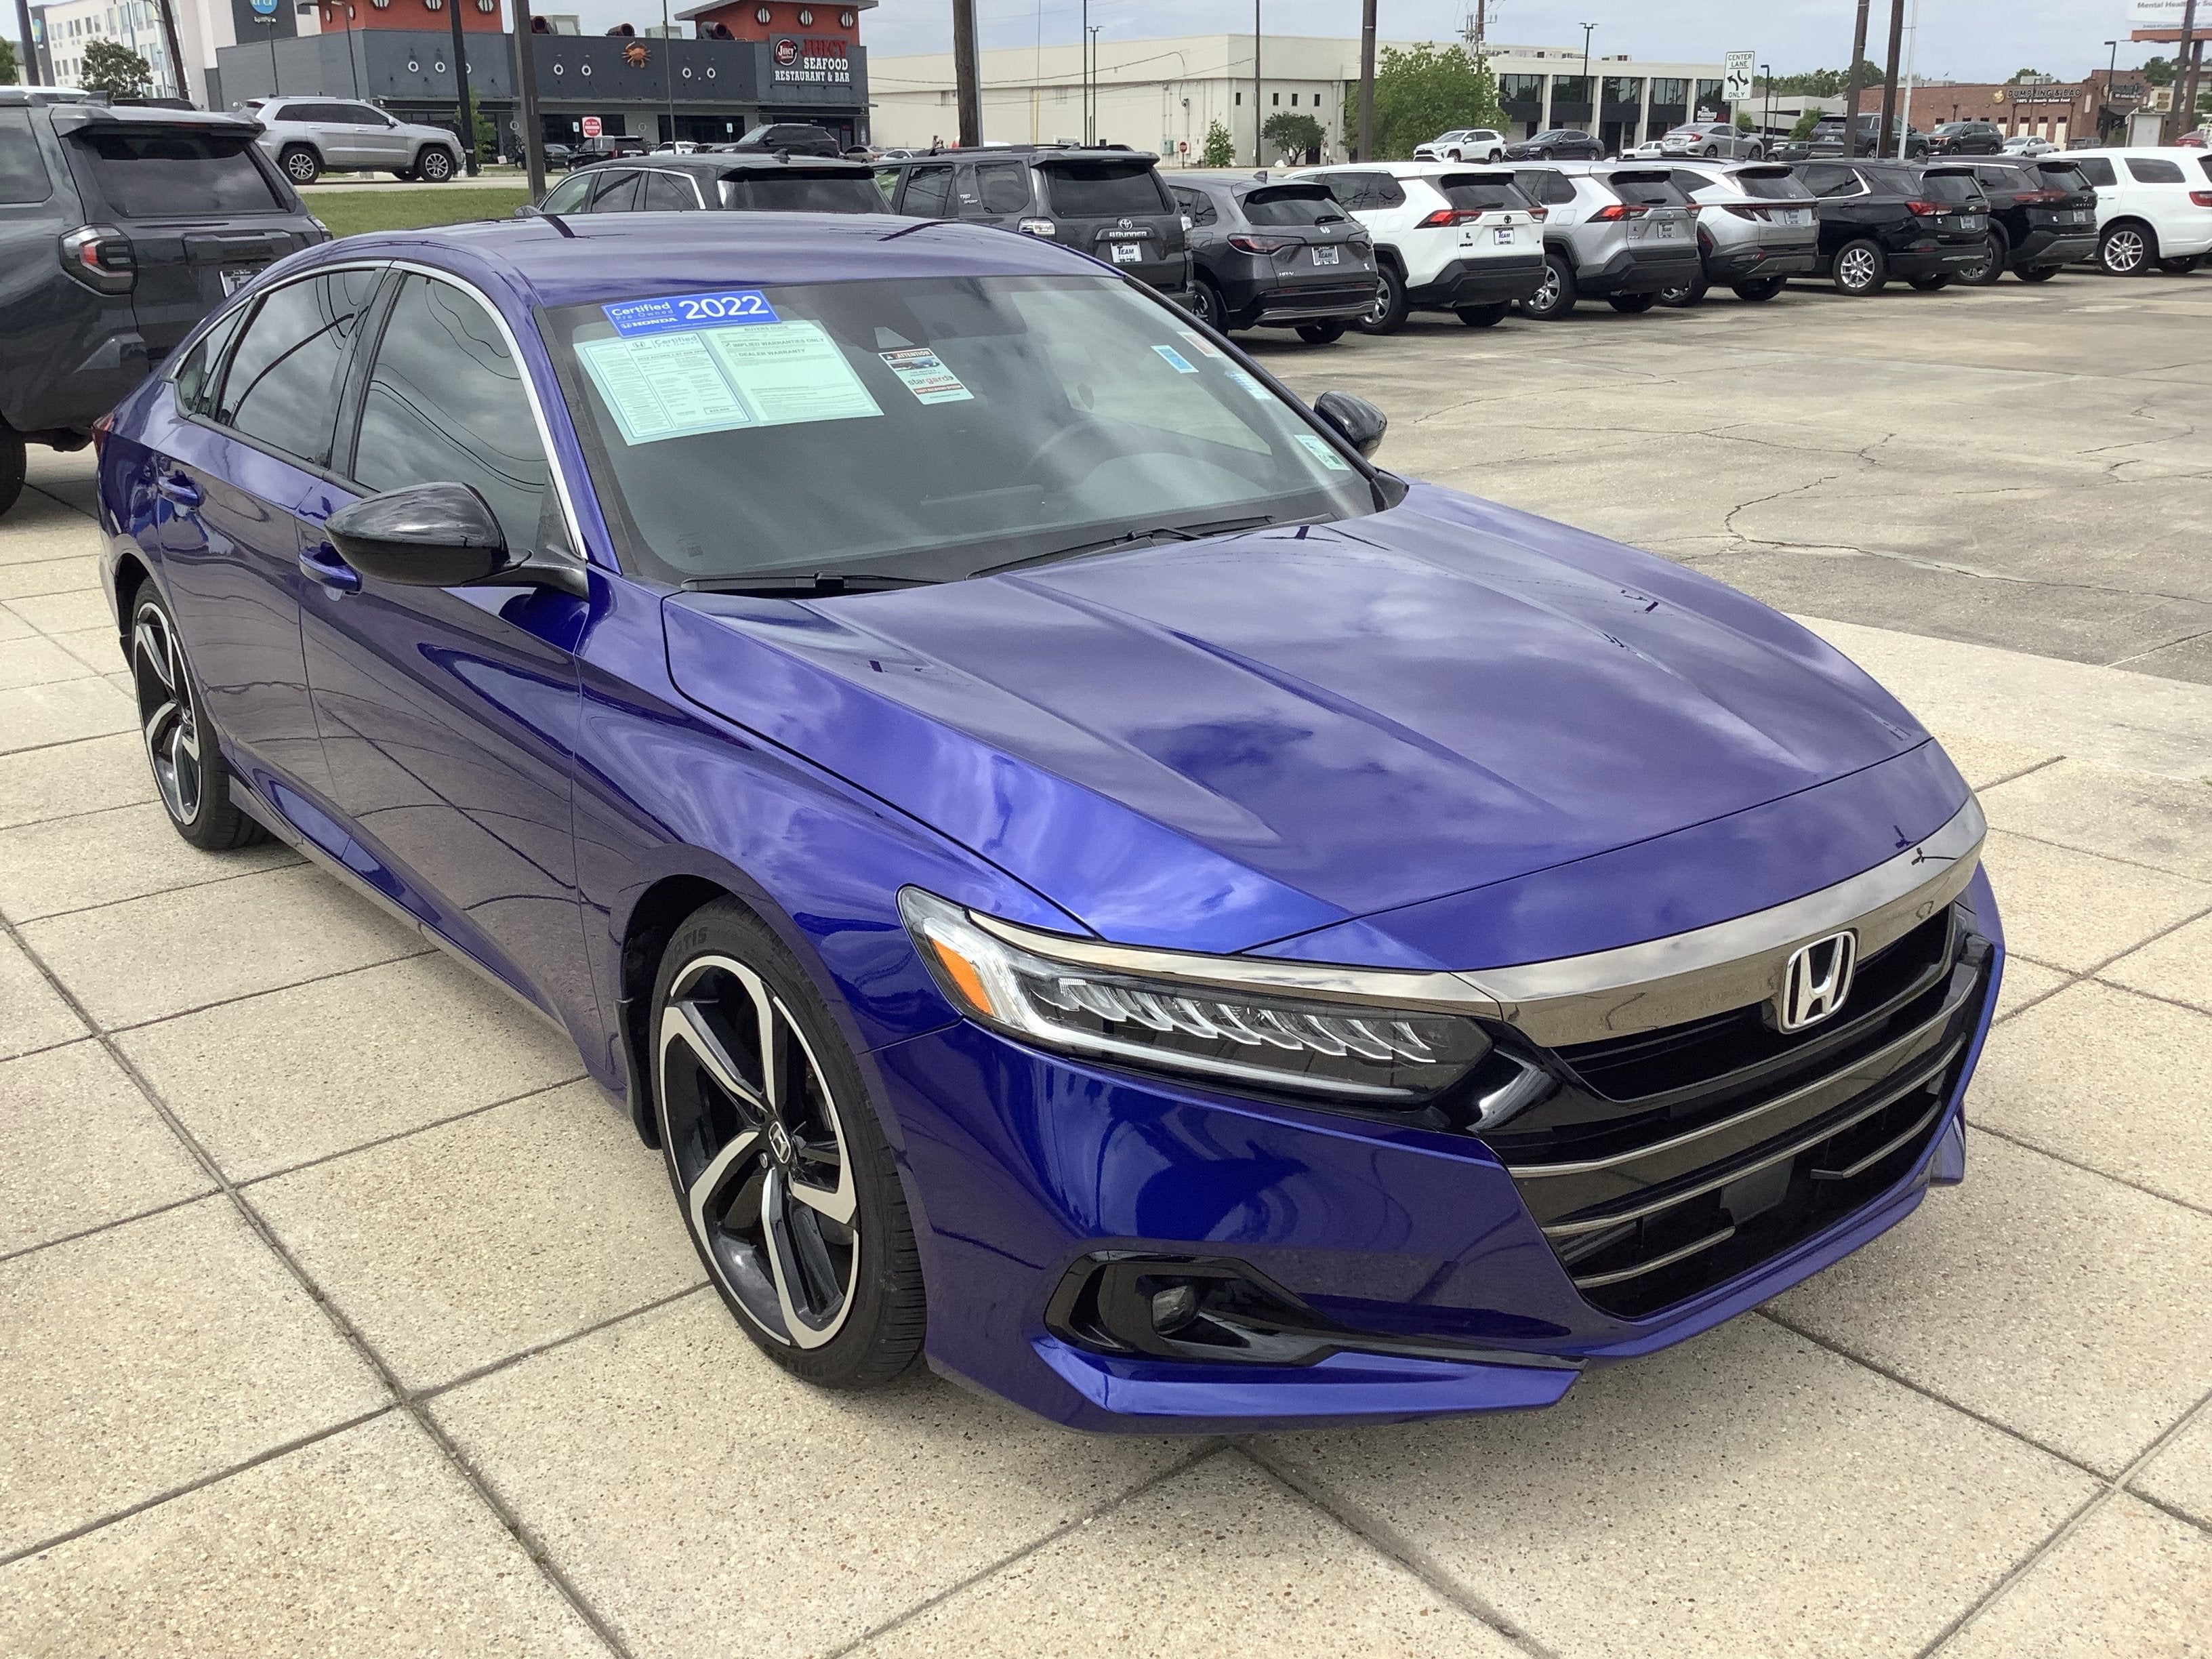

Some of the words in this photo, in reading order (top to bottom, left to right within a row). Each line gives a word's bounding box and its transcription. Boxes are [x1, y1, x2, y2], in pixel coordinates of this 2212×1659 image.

[801, 39, 846, 58] JUICY
[804, 57, 848, 70] SEAFOOD
[775, 70, 825, 81] RESTAURANT
[827, 71, 833, 82] &
[834, 72, 850, 82] BAR
[1117, 246, 1134, 255] TEAM
[611, 302, 671, 316] Certified
[678, 295, 770, 320] 2022
[632, 317, 679, 326] HONDA
[655, 335, 697, 345] Certified
[897, 350, 930, 359] ATTENTION
[908, 375, 950, 385] stargard
